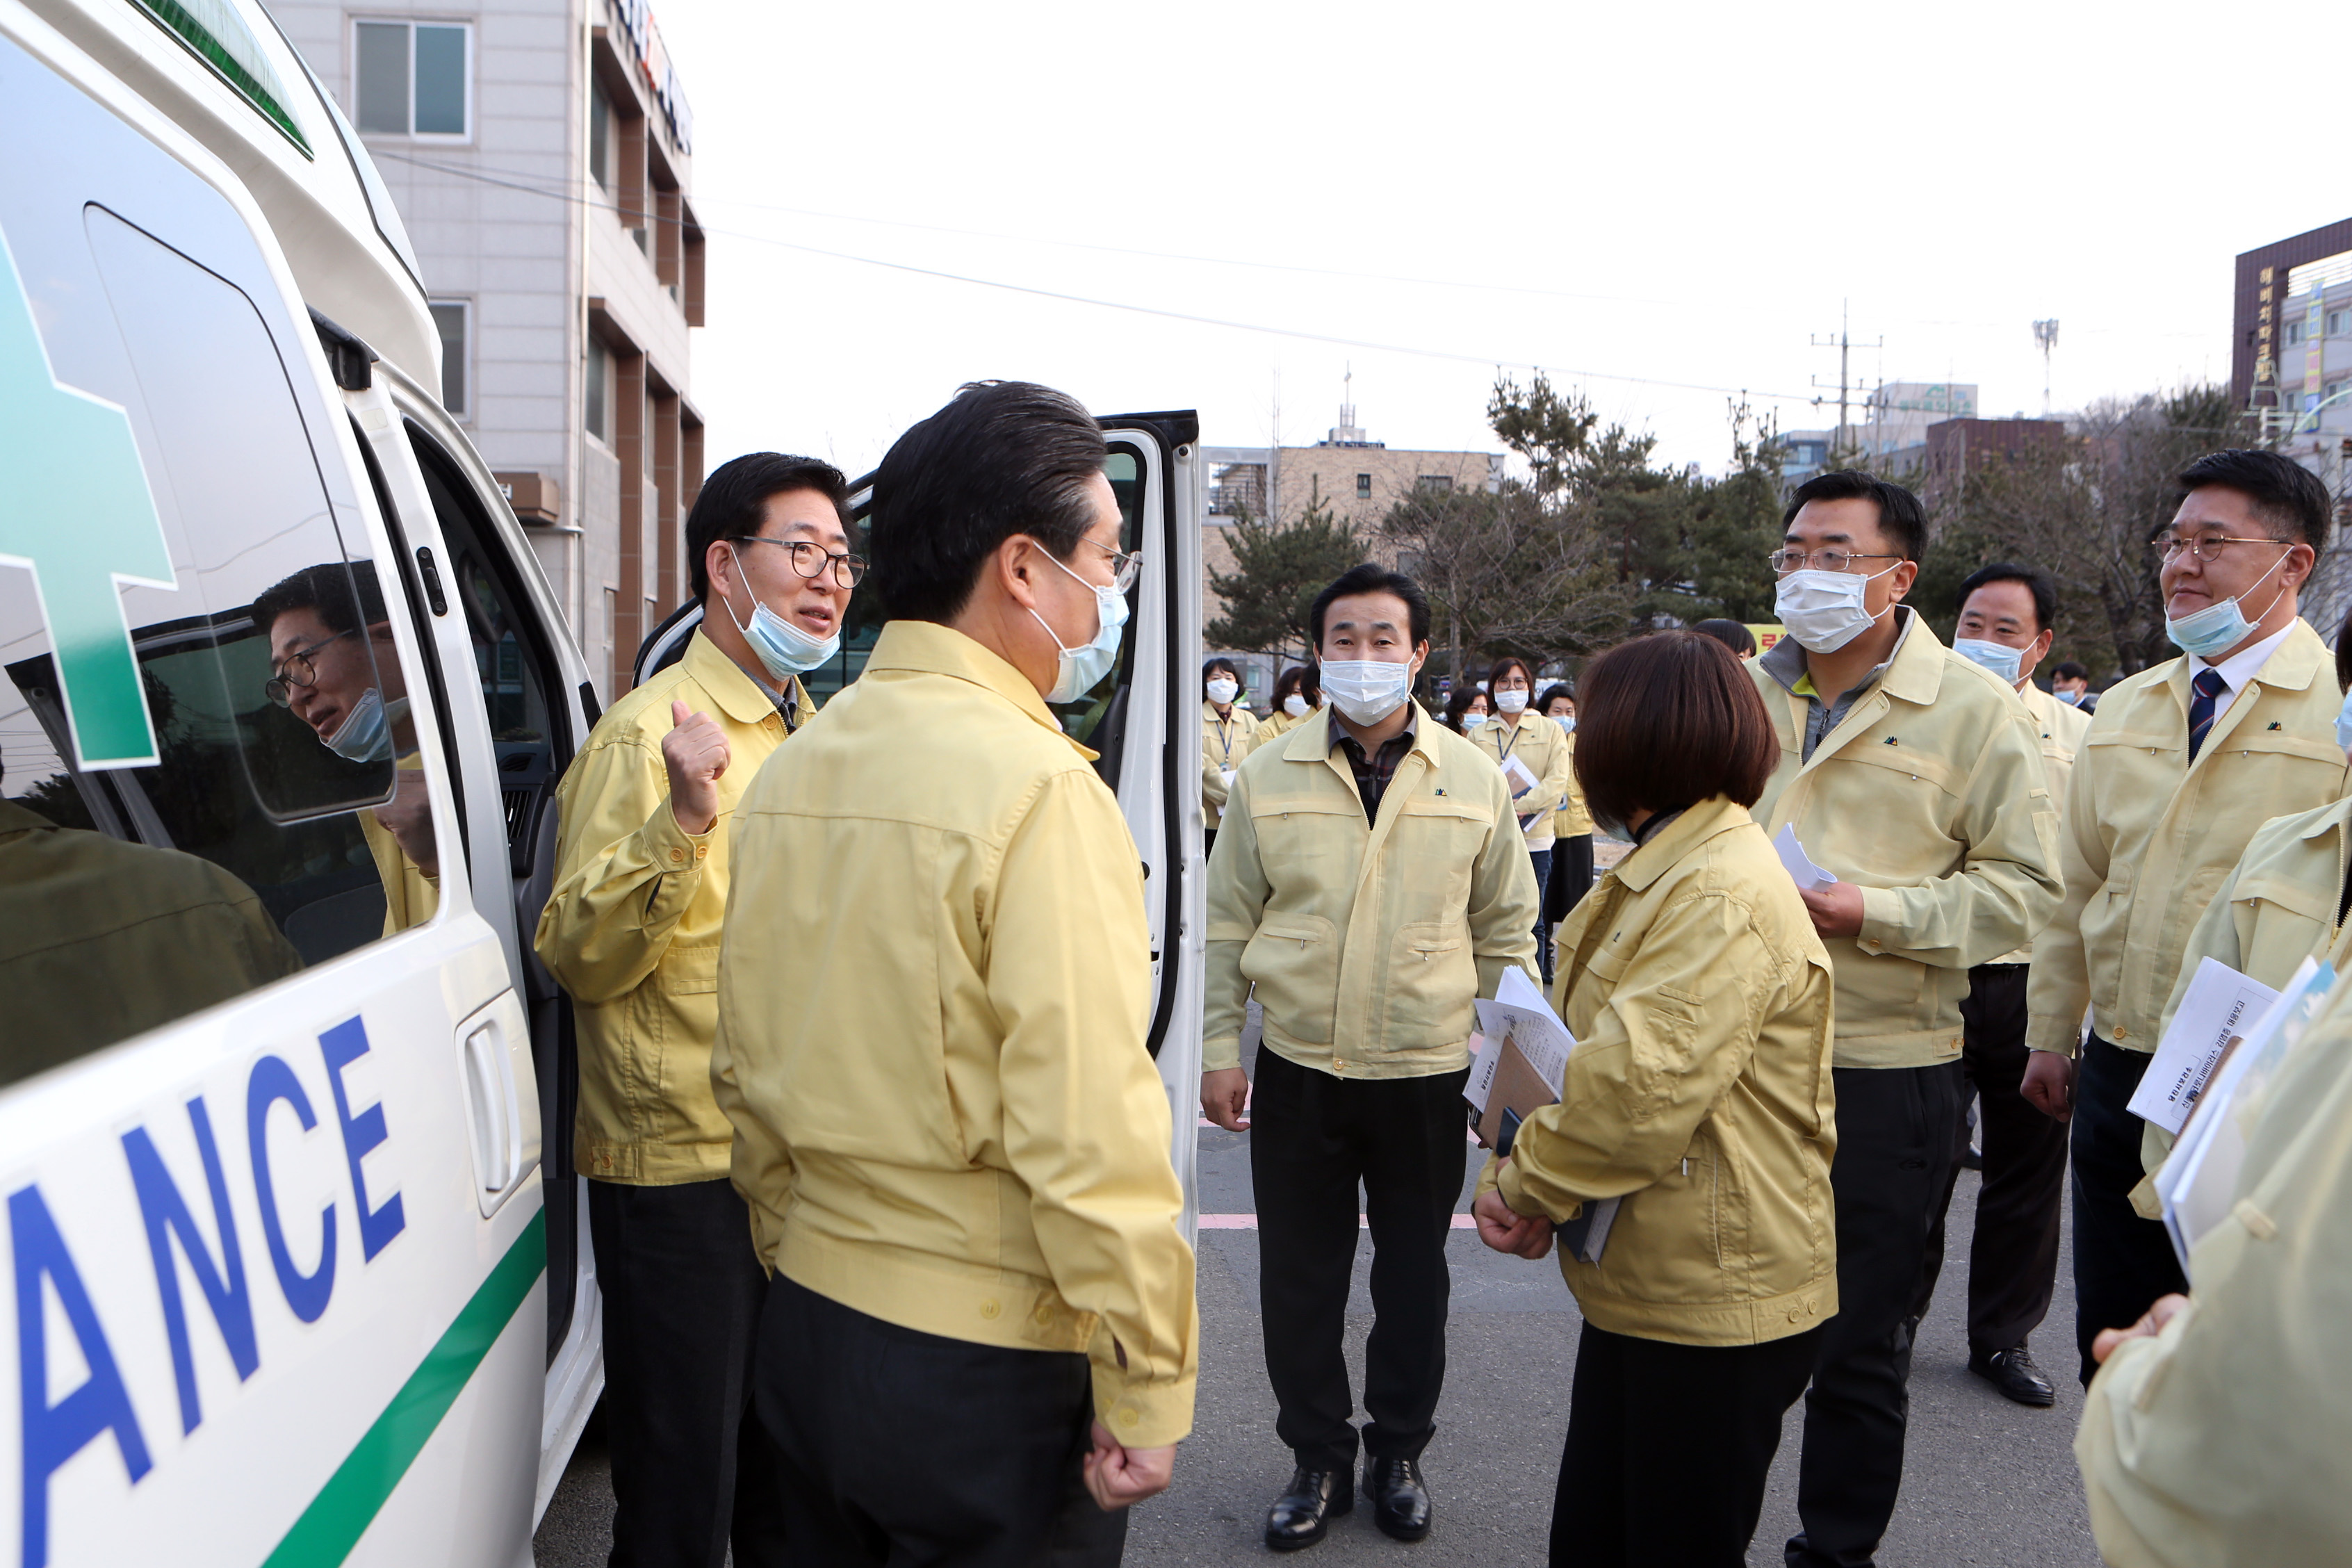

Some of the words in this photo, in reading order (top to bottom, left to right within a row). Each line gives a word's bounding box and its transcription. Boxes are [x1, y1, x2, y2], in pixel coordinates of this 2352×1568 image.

[2227, 999, 2245, 1027] 대응보고
[2169, 1067, 2191, 1102] 당진시보건소
[7, 1014, 405, 1568] ANCE
